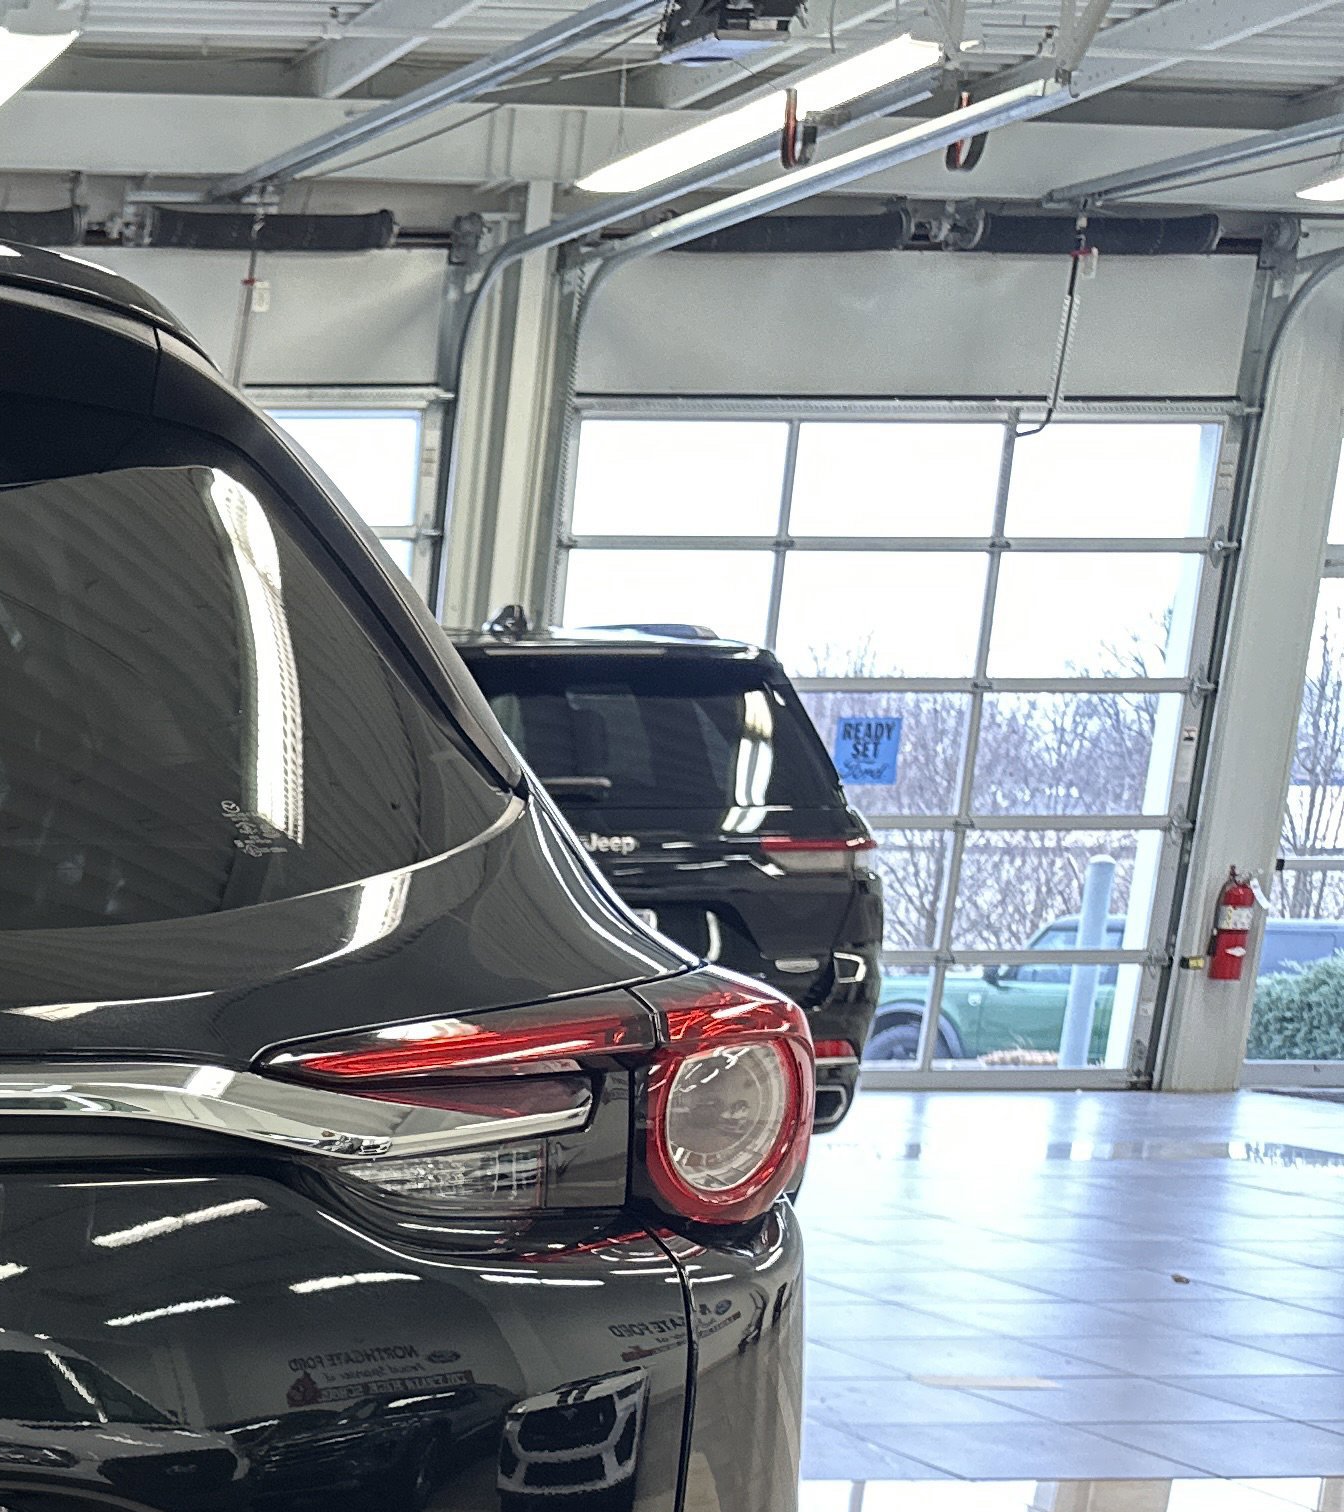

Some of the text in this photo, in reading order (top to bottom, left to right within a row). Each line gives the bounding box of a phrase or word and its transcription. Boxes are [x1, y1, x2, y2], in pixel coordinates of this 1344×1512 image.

[843, 722, 896, 740] READY
[852, 740, 881, 759] SET
[582, 832, 636, 856] Jeep
